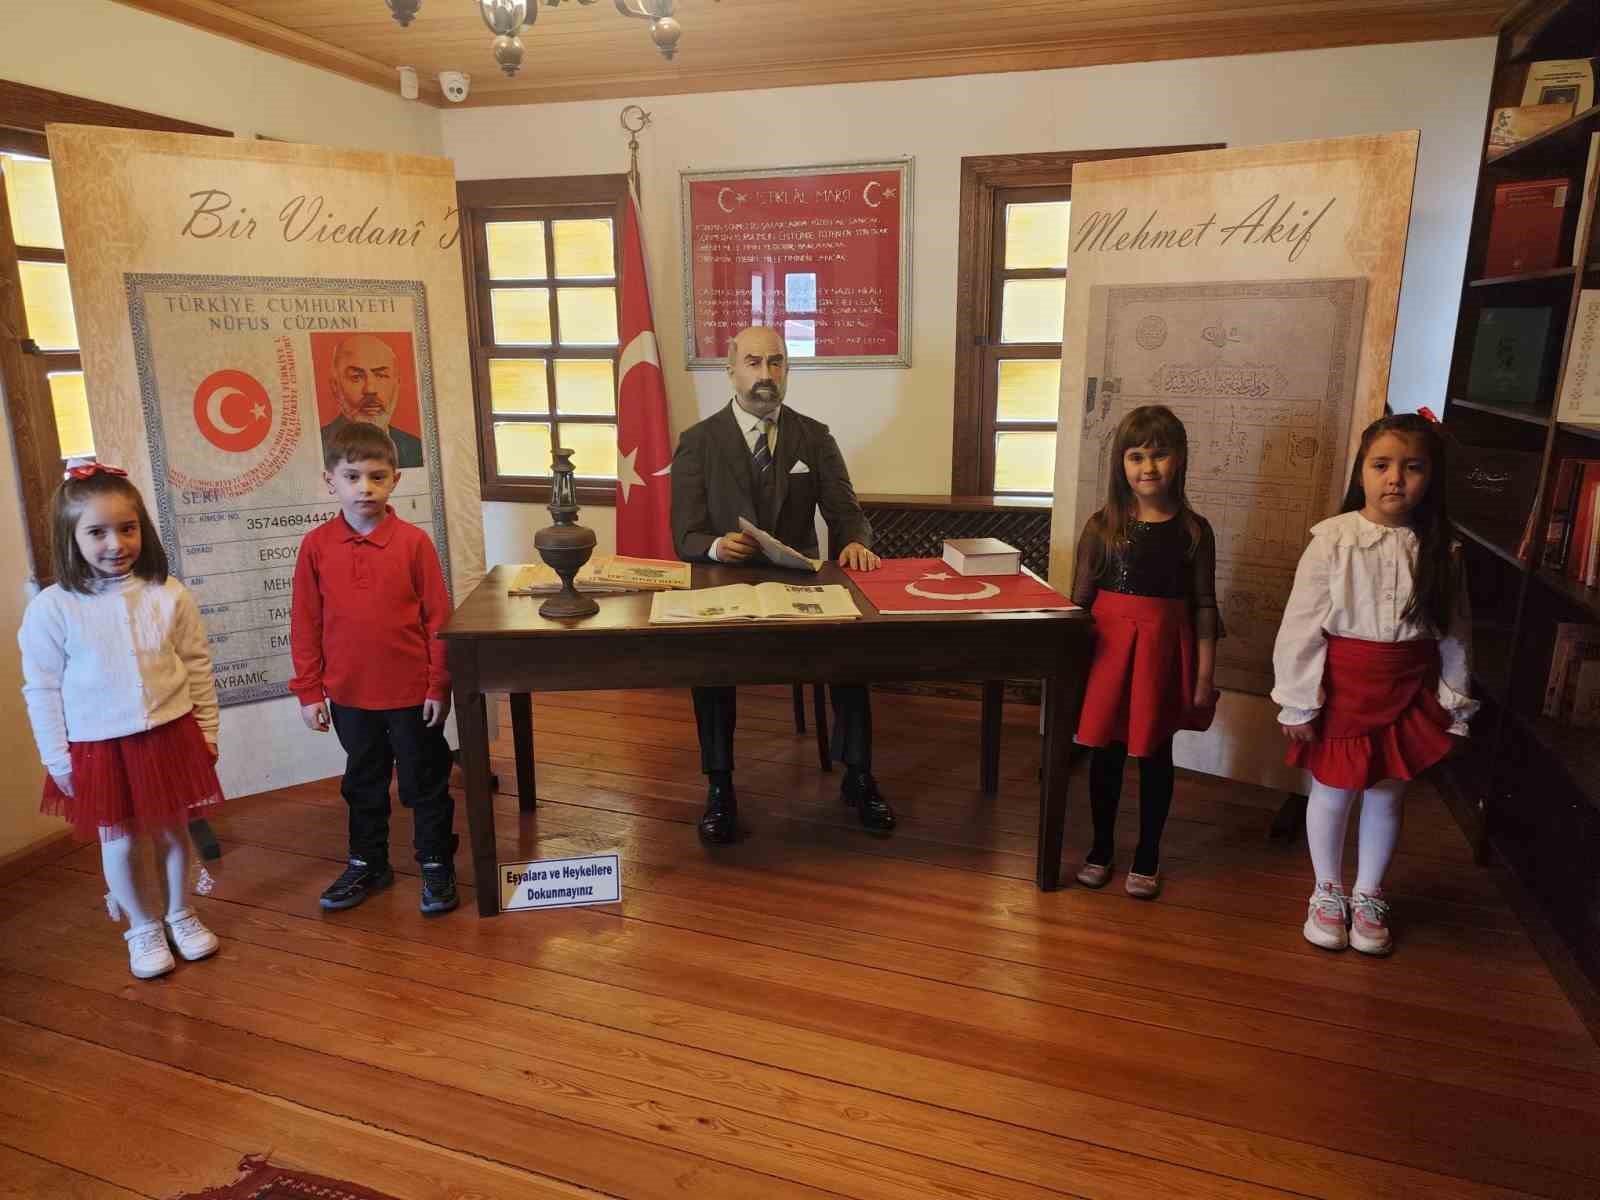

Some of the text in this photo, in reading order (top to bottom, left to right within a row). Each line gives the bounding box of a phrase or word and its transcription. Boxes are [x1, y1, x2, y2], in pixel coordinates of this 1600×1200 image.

[181, 189, 257, 240] Bir
[279, 195, 426, 247] Vicdanî
[1073, 193, 1337, 263] Mehmet Akif
[209, 316, 270, 330] NÜFUS
[259, 546, 299, 562] ERSOY
[264, 579, 291, 593] MEH
[268, 607, 291, 621] TAH
[506, 864, 613, 886] Eşyalara ve Heykellere
[527, 885, 593, 901] Dokunmayınız
